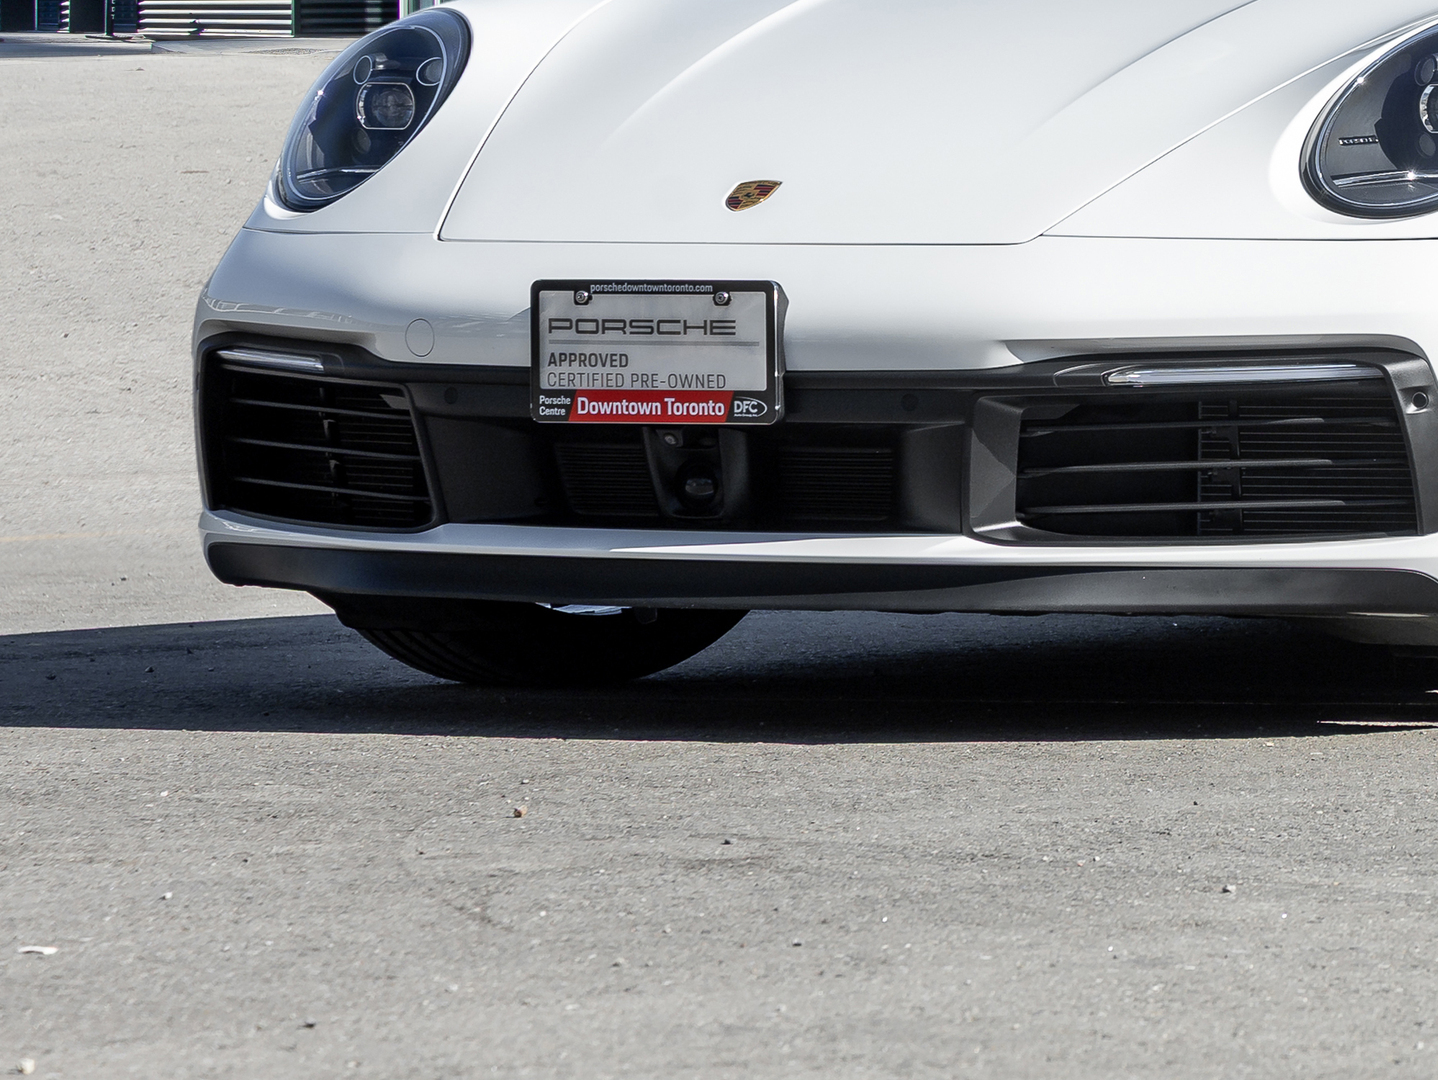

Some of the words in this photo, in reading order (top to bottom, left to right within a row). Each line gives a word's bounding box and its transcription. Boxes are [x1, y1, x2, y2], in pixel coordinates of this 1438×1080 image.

[590, 282, 713, 293] porschedowntowntoronto.com
[548, 318, 736, 335] PORSCHE
[547, 352, 629, 368] APPROVED
[547, 372, 625, 388] CERTIFIED
[630, 373, 726, 389] PRE-OWNED
[539, 395, 571, 405] Porsche
[577, 396, 662, 415] Downtown
[664, 397, 725, 416] Toronto
[734, 400, 758, 413] DFC
[539, 406, 566, 416] Centre
